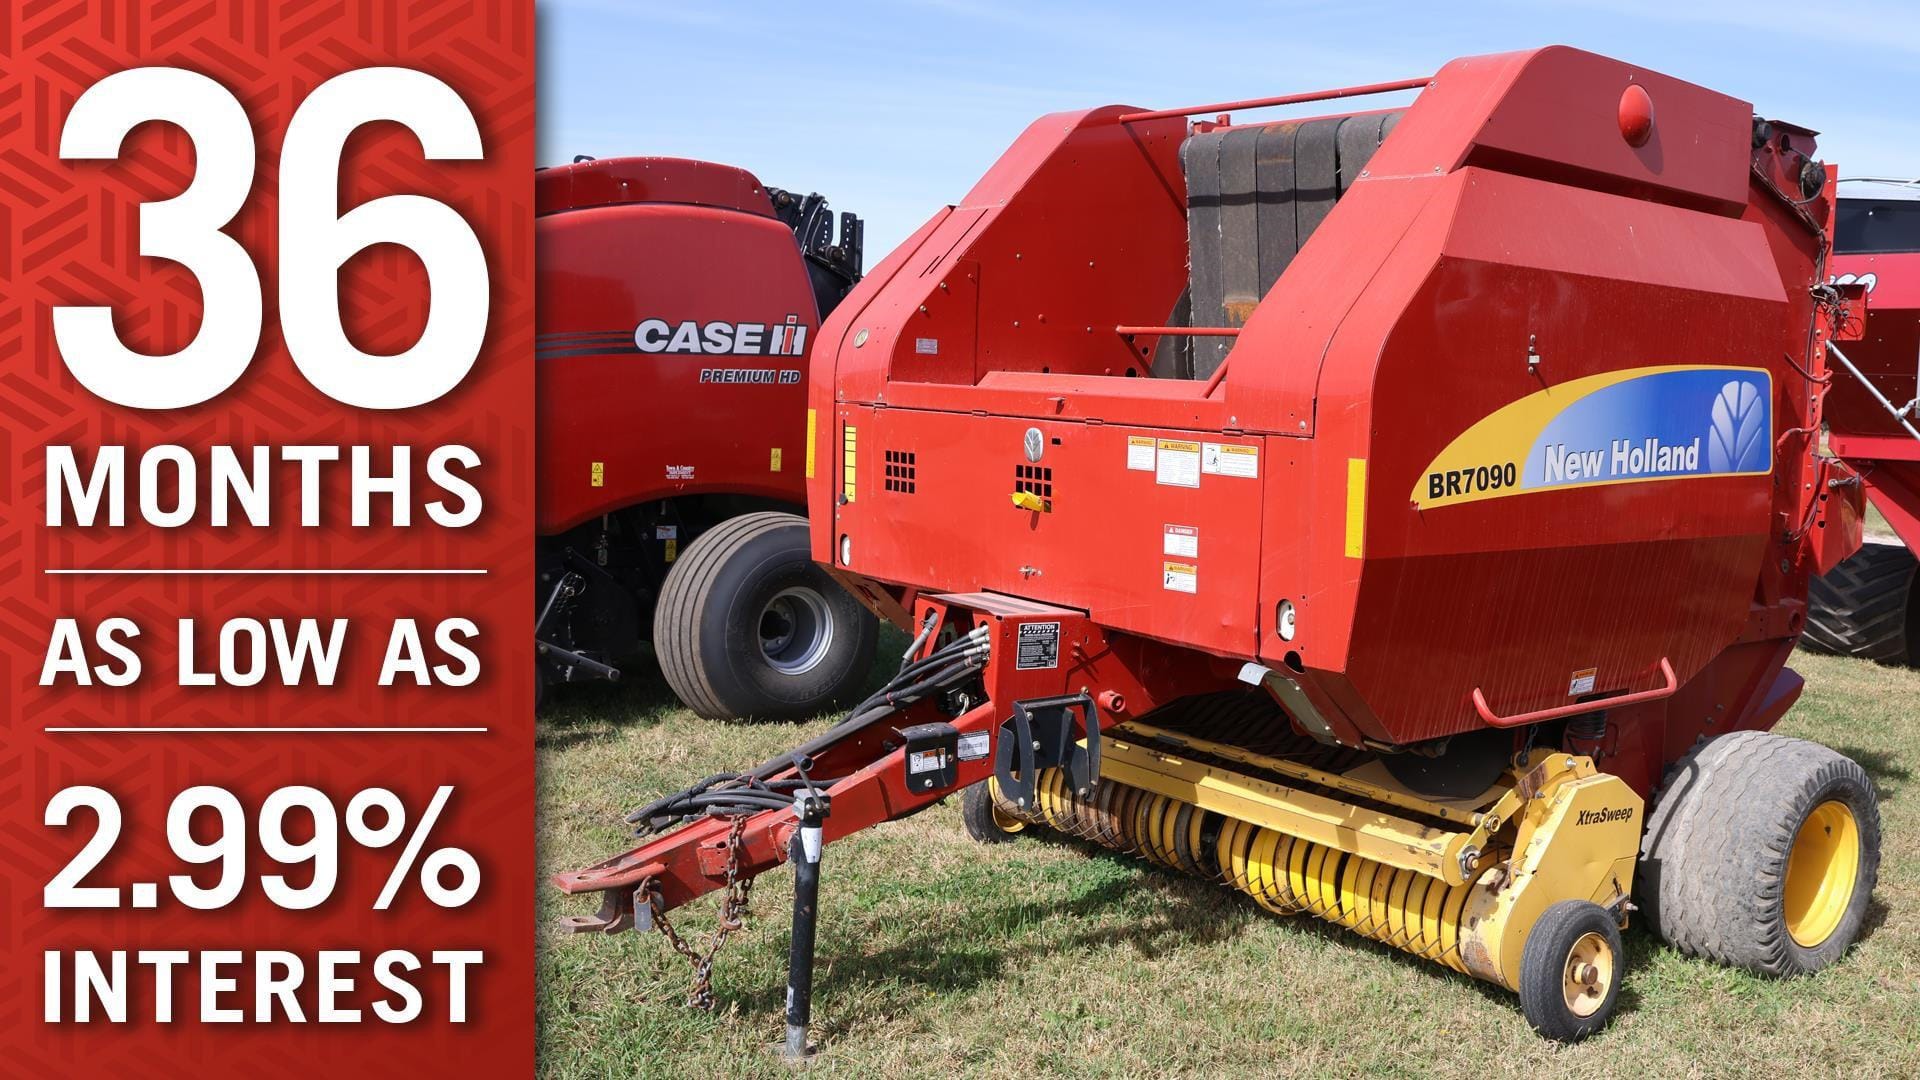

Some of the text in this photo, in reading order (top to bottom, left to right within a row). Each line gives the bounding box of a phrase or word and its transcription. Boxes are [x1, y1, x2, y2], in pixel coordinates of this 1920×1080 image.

[633, 318, 765, 355] CASE
[700, 368, 801, 385] PREMIUM HD
[1170, 443, 1193, 451] WARNING
[1543, 436, 1701, 483] New Holland
[1428, 462, 1517, 499] BR7090
[1575, 807, 1633, 826] XtraSweep
